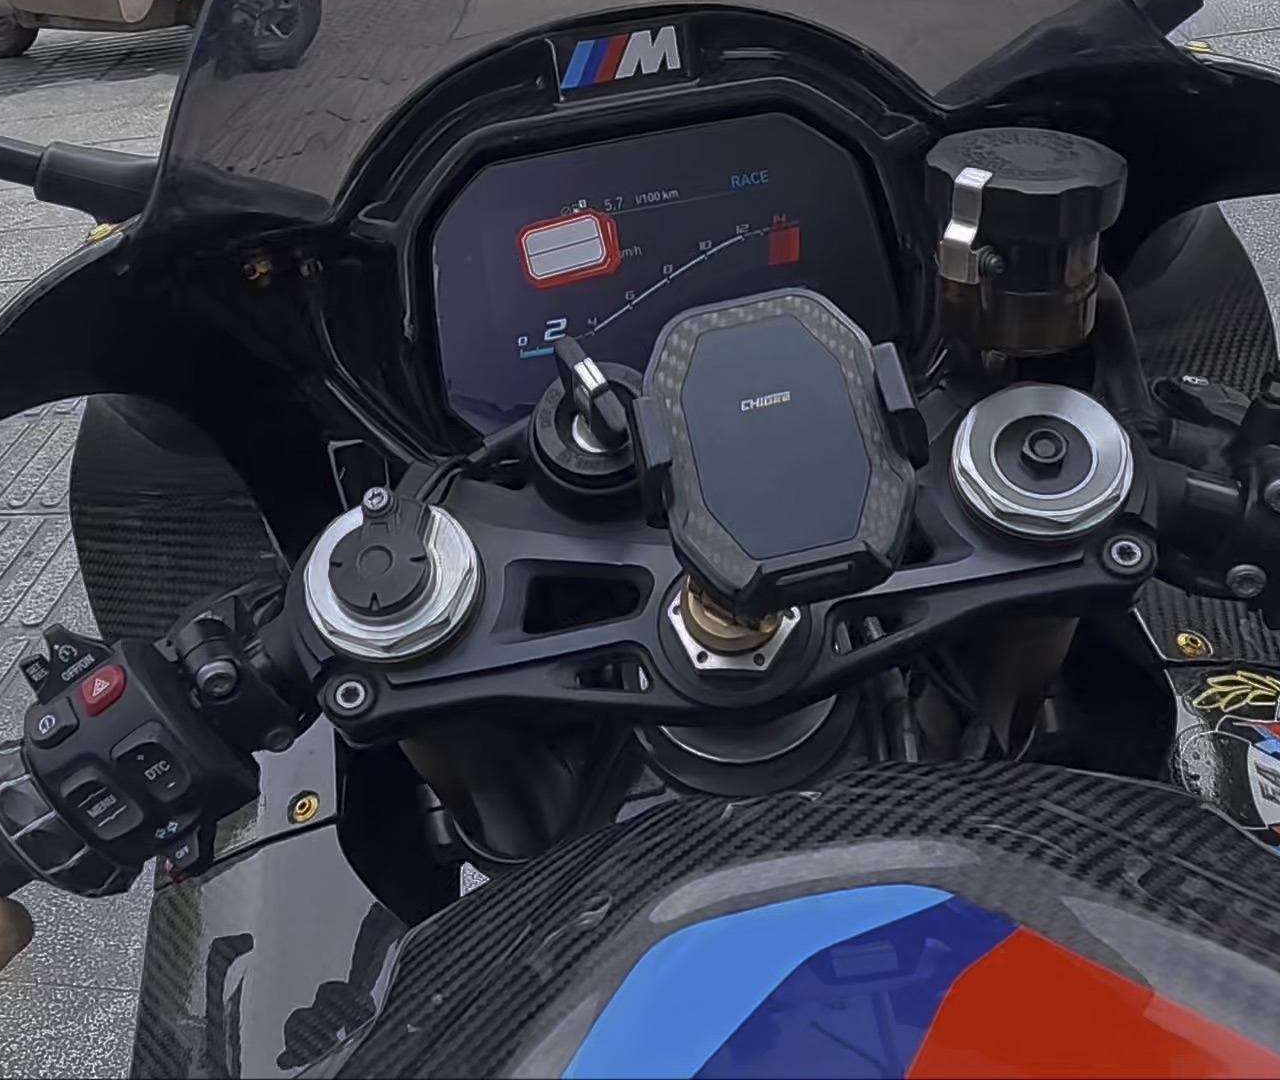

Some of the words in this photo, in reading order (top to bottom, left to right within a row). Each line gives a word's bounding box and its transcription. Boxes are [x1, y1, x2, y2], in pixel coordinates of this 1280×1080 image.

[614, 25, 680, 79] M
[731, 170, 769, 189] RACE
[604, 196, 624, 212] 5.7
[544, 318, 568, 342] 2
[144, 760, 170, 780] DTC
[86, 794, 117, 819] MENU
